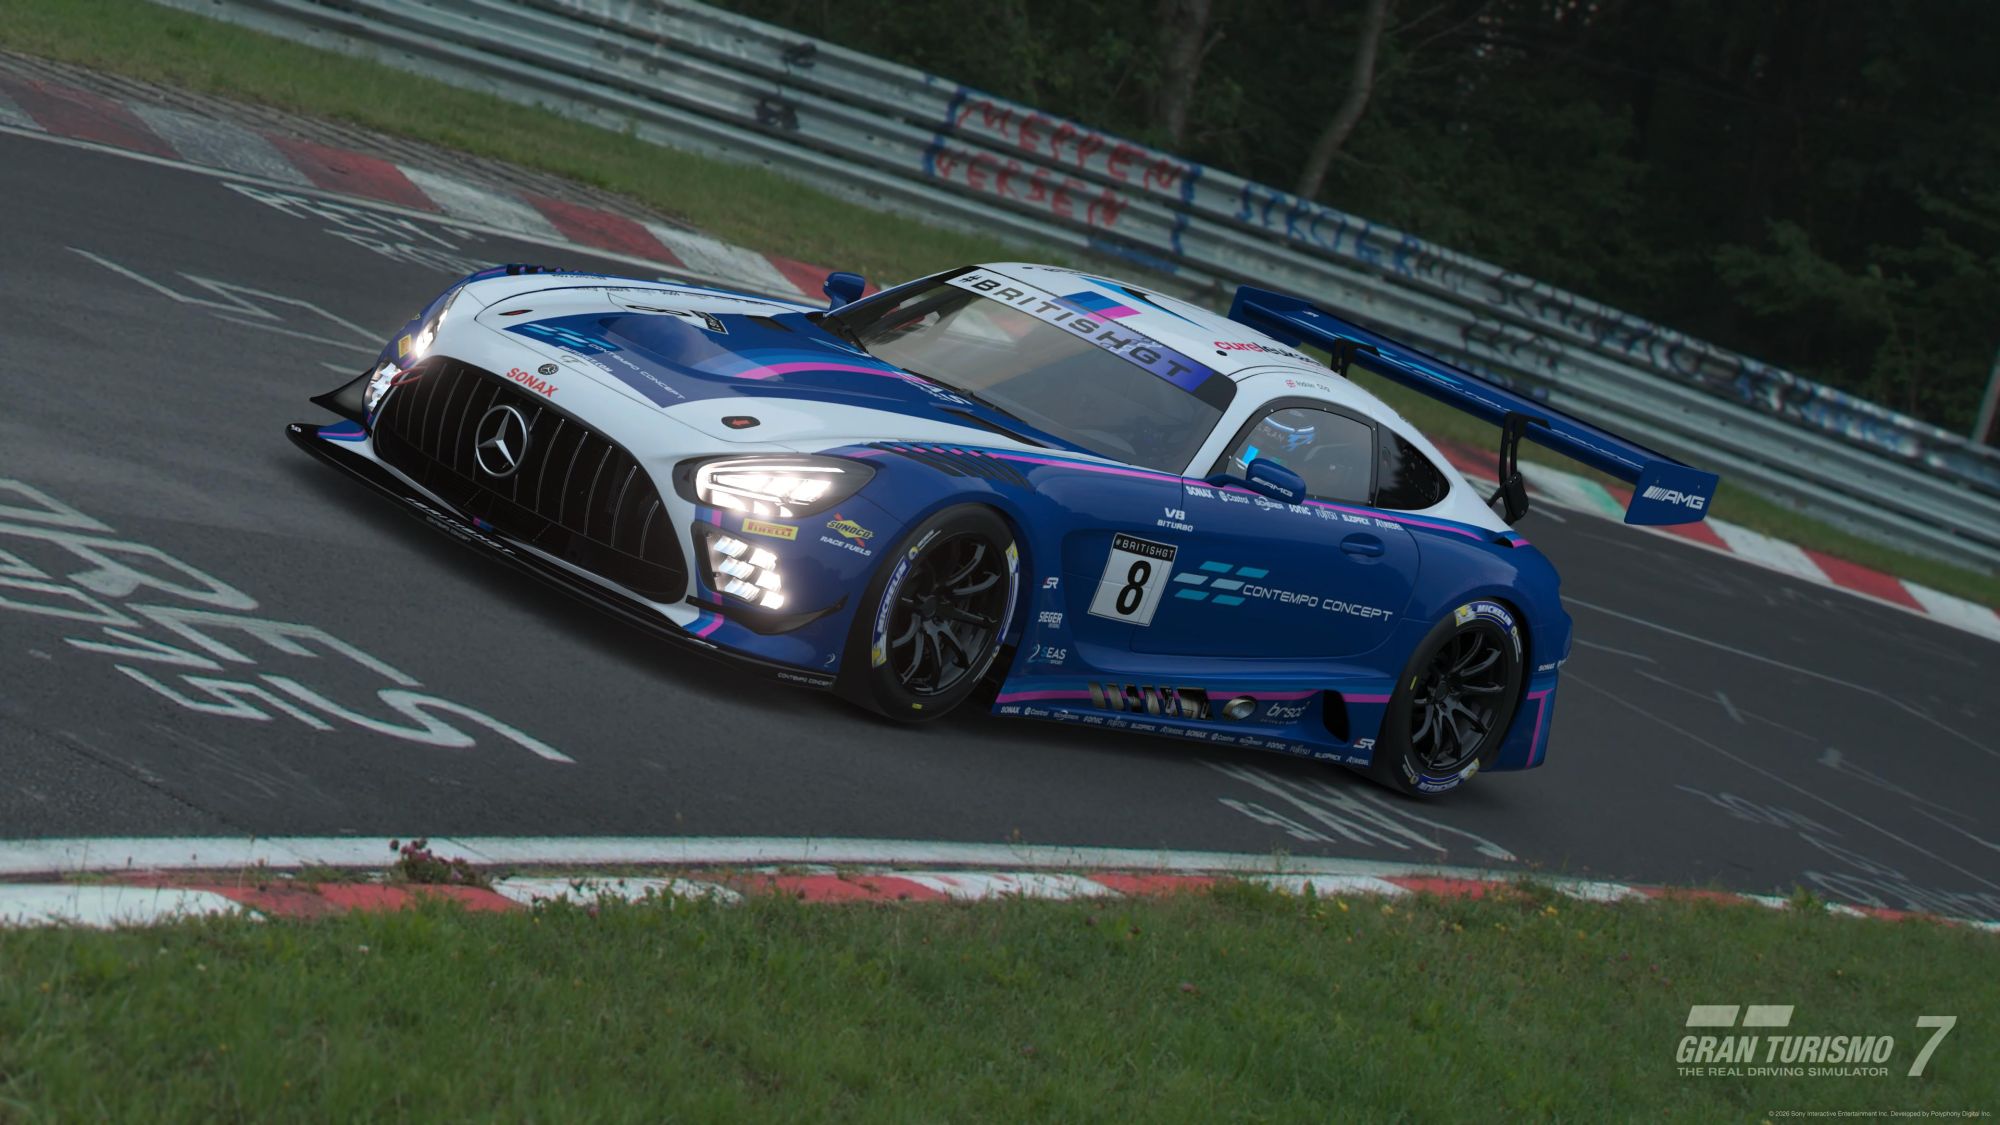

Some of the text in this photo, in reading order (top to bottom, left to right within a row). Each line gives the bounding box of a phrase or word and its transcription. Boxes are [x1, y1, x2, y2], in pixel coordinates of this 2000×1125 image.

[960, 273, 1193, 379] #BRITISHGT
[506, 367, 559, 398] SONAX
[1186, 486, 1215, 499] SONAX
[1165, 507, 1186, 521] V8
[747, 521, 793, 538] PIRELLI
[827, 519, 873, 539] SUNOCO
[1157, 519, 1194, 533] BITURBO
[820, 535, 872, 557] RACE FUELS
[1115, 560, 1151, 617] 8
[1242, 584, 1393, 622] CONTEMPO CONCEPT
[1038, 611, 1063, 624] SIEGER
[1476, 604, 1513, 626] MICHELIN
[1040, 646, 1067, 660] SEAS
[1000, 706, 1021, 715] SONAX
[1353, 738, 1376, 750] SR
